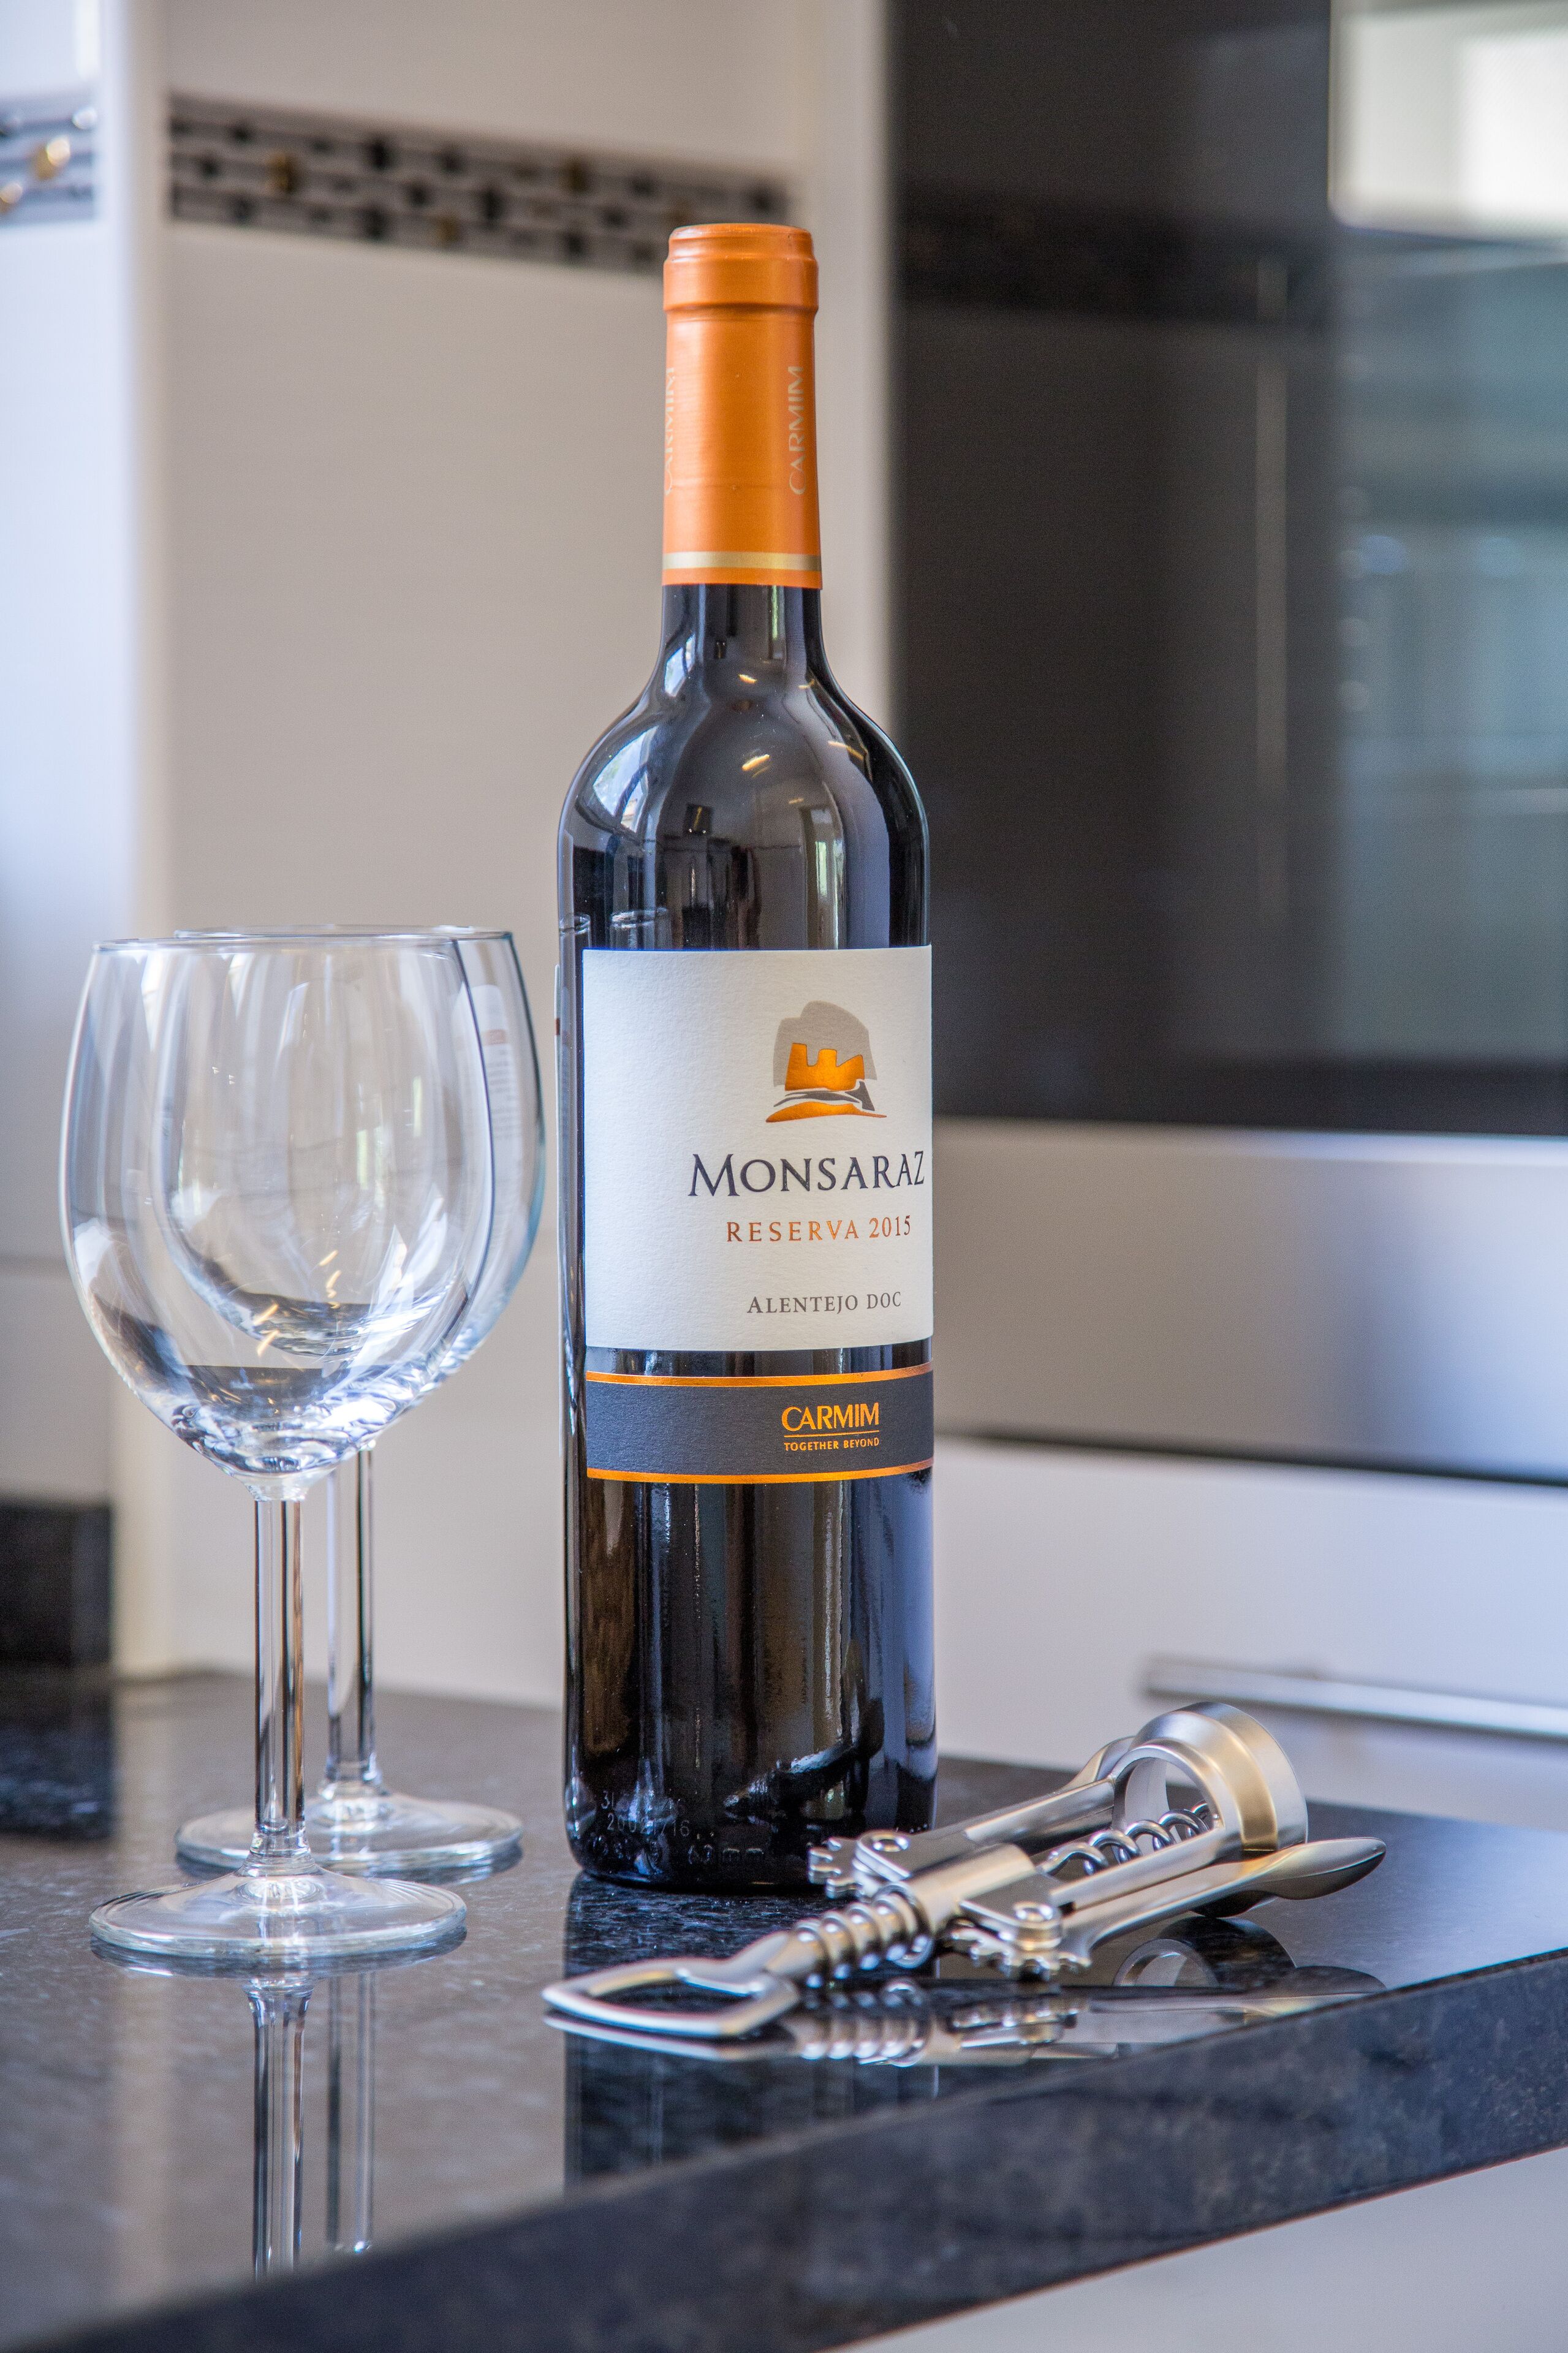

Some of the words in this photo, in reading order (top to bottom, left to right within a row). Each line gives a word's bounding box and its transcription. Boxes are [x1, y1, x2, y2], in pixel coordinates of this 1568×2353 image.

[787, 366, 806, 495] CARMIM
[687, 1151, 925, 1197] MONSARAZ
[726, 1219, 859, 1243] RESERVA
[869, 1215, 911, 1239] 2015
[746, 1295, 858, 1314] ALENTEJO
[866, 1291, 901, 1309] DOC
[781, 1402, 880, 1431] CARMIM
[784, 1441, 839, 1452] TOGETHER
[843, 1437, 880, 1449] BEYOND
